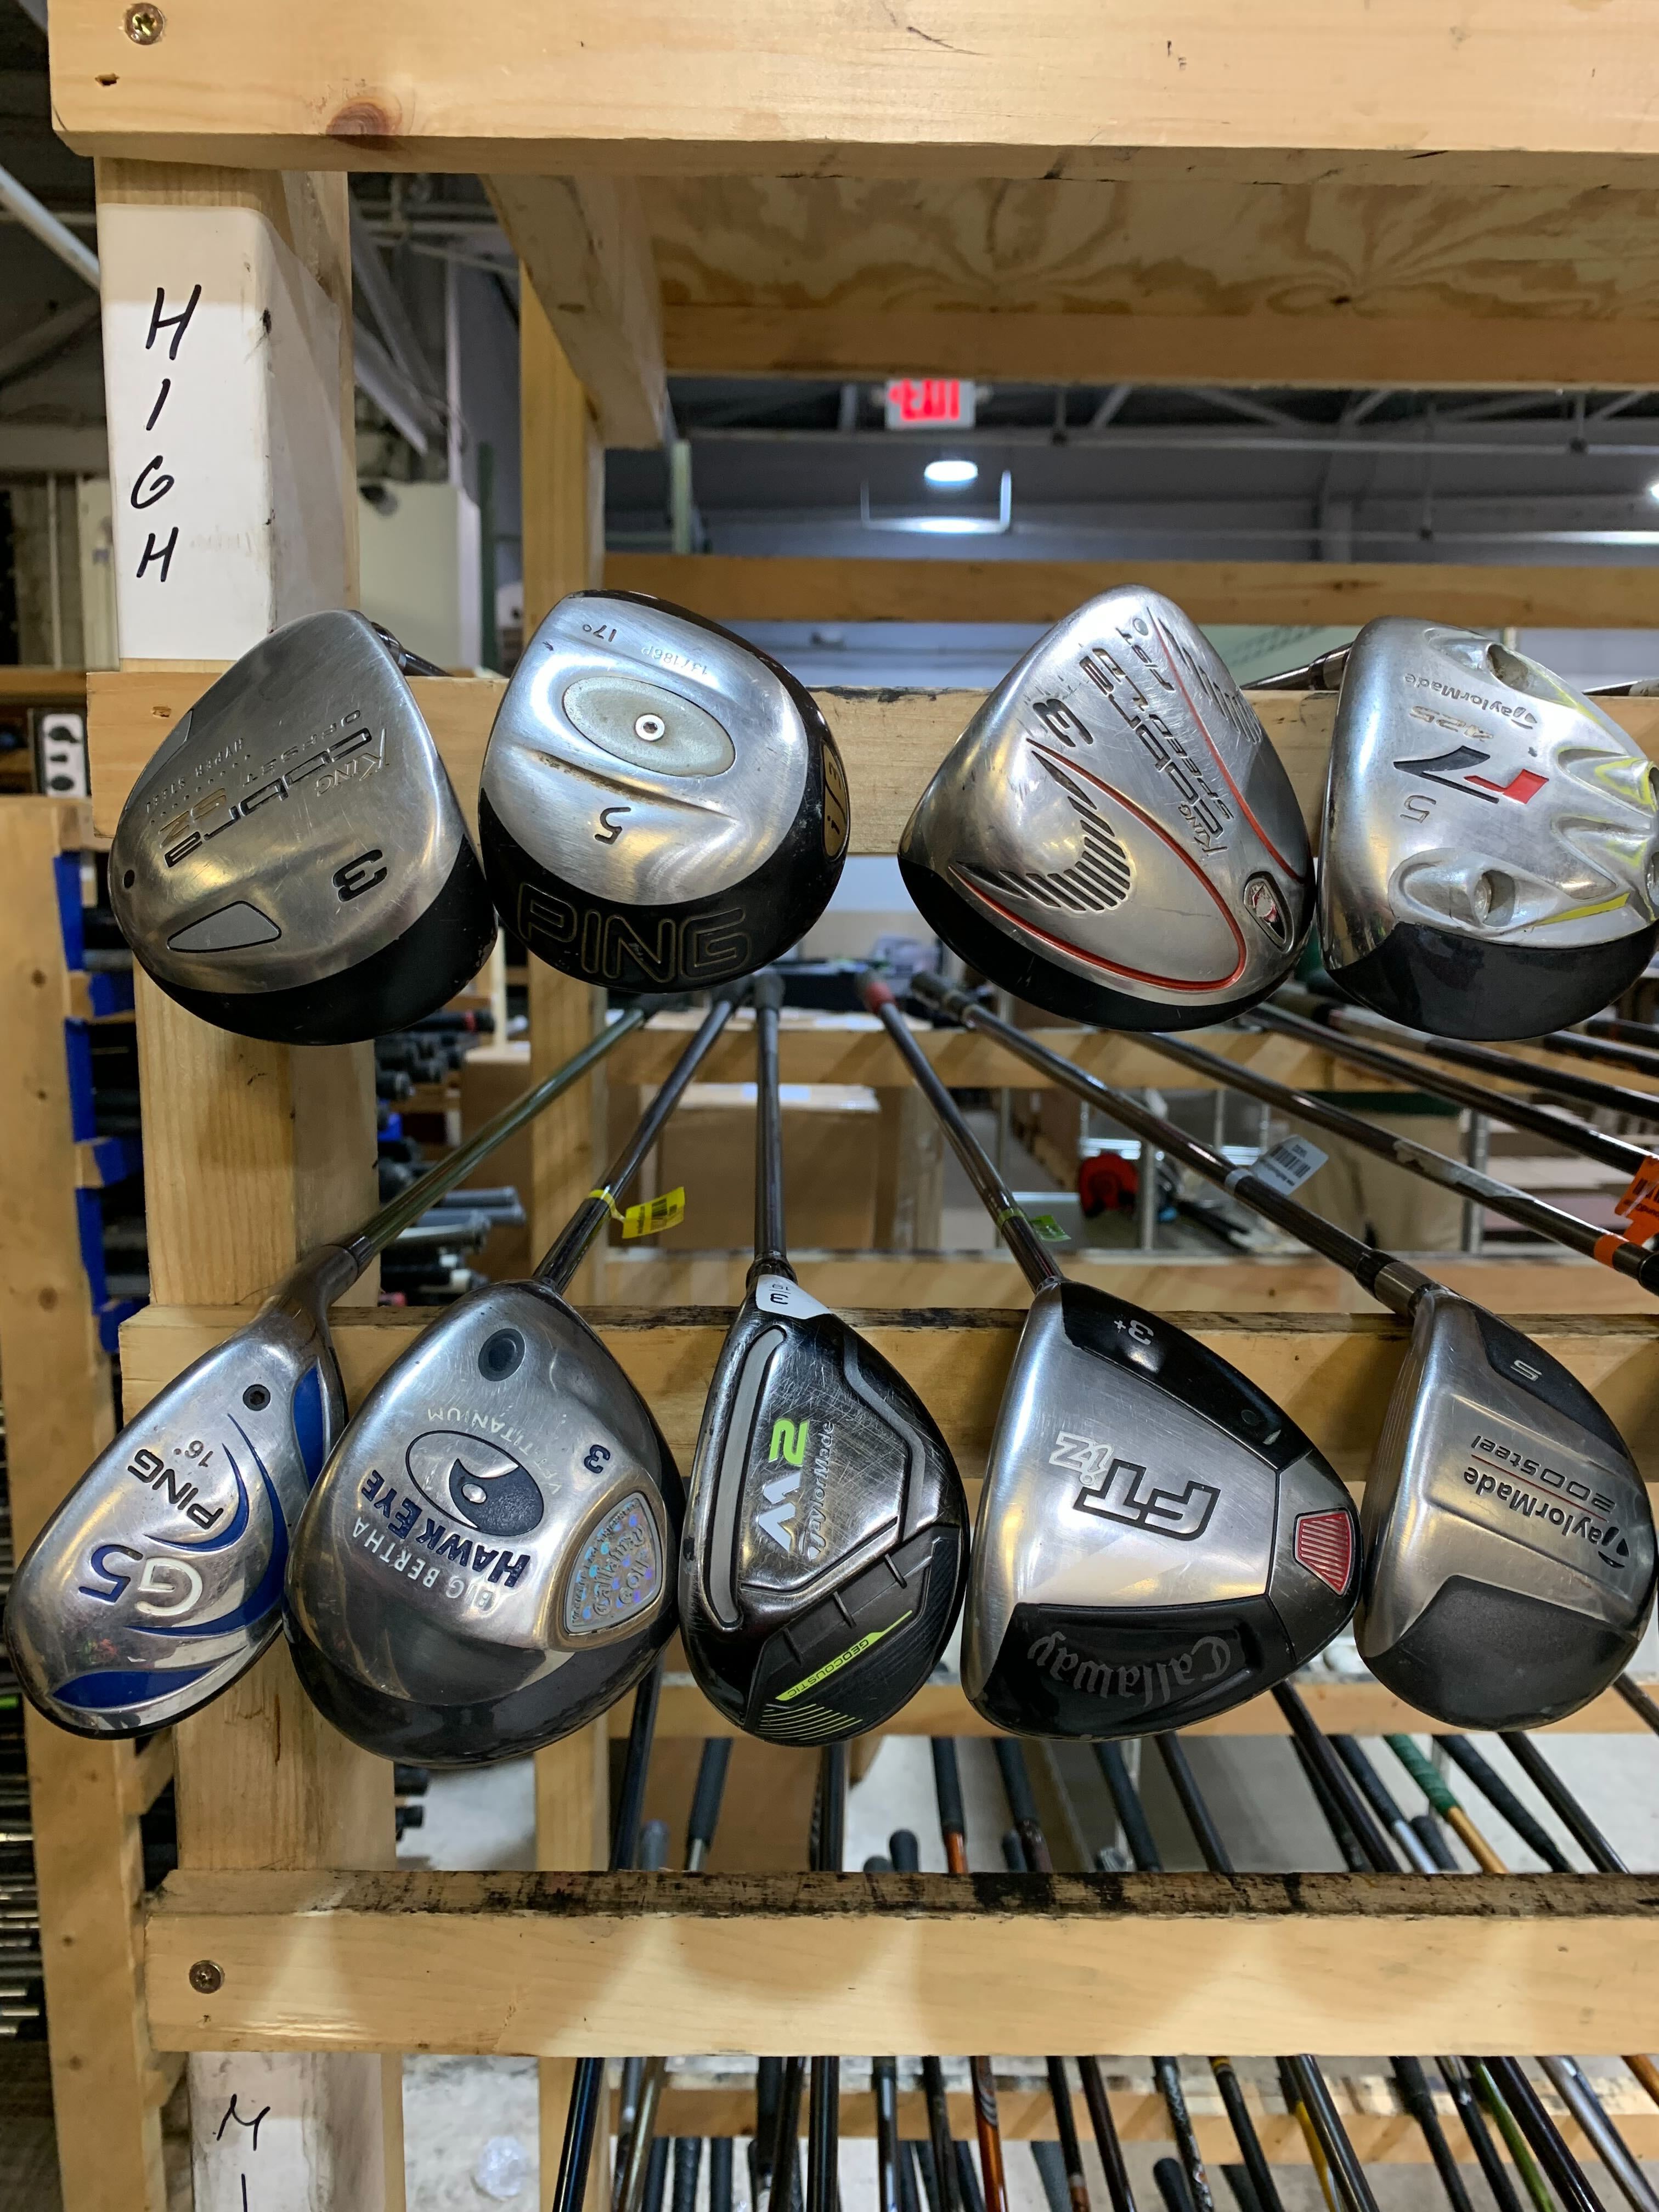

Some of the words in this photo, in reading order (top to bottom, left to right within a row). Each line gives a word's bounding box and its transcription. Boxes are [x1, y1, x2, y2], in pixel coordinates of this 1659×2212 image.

[131, 284, 201, 582] HIGH
[1092, 648, 1150, 712] LD
[1404, 673, 1537, 730] TaylorMade
[242, 710, 360, 786] OFFSET
[1033, 698, 1093, 747] 3
[1409, 706, 1494, 741] 425
[195, 737, 245, 776] HYPER
[1149, 714, 1234, 820] SPEED
[594, 806, 631, 844] 5
[1401, 794, 1437, 823] 5
[332, 849, 388, 901] 3
[517, 882, 752, 982] PING
[770, 1294, 788, 1305] 3
[1510, 1360, 1542, 1381] 5
[427, 1407, 533, 1455] TITANIUM
[584, 1444, 611, 1474] 3
[128, 1448, 223, 1530] PING
[757, 1419, 810, 1559] M2
[799, 1420, 834, 1561] TaylorMade
[1073, 1459, 1221, 1541] FT
[1463, 1465, 1631, 1569] TaylorMade
[78, 1544, 203, 1616] G5
[352, 1516, 442, 1589] BERTHA
[446, 1579, 494, 1611] BIG
[788, 1640, 869, 1697] GEOCOUSTIC
[1028, 1631, 1232, 1706] Callaway
